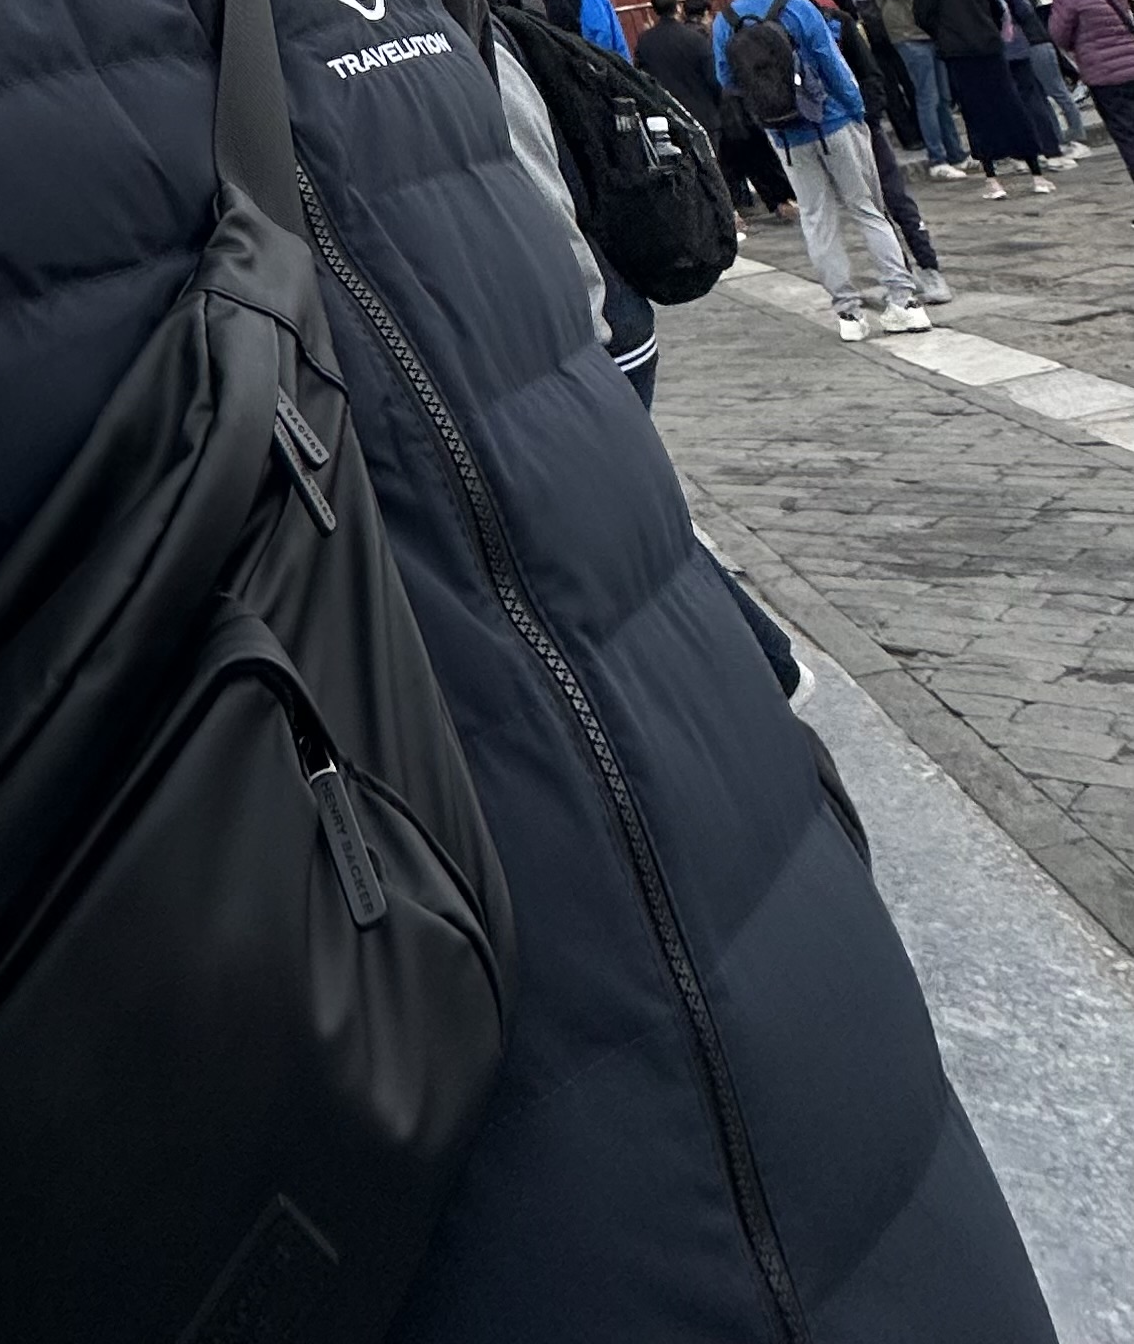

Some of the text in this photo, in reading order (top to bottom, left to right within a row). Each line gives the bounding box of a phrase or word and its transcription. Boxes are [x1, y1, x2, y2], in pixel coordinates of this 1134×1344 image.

[326, 32, 452, 79] TRAVELUTION
[320, 781, 375, 915] HENRY BACKER
